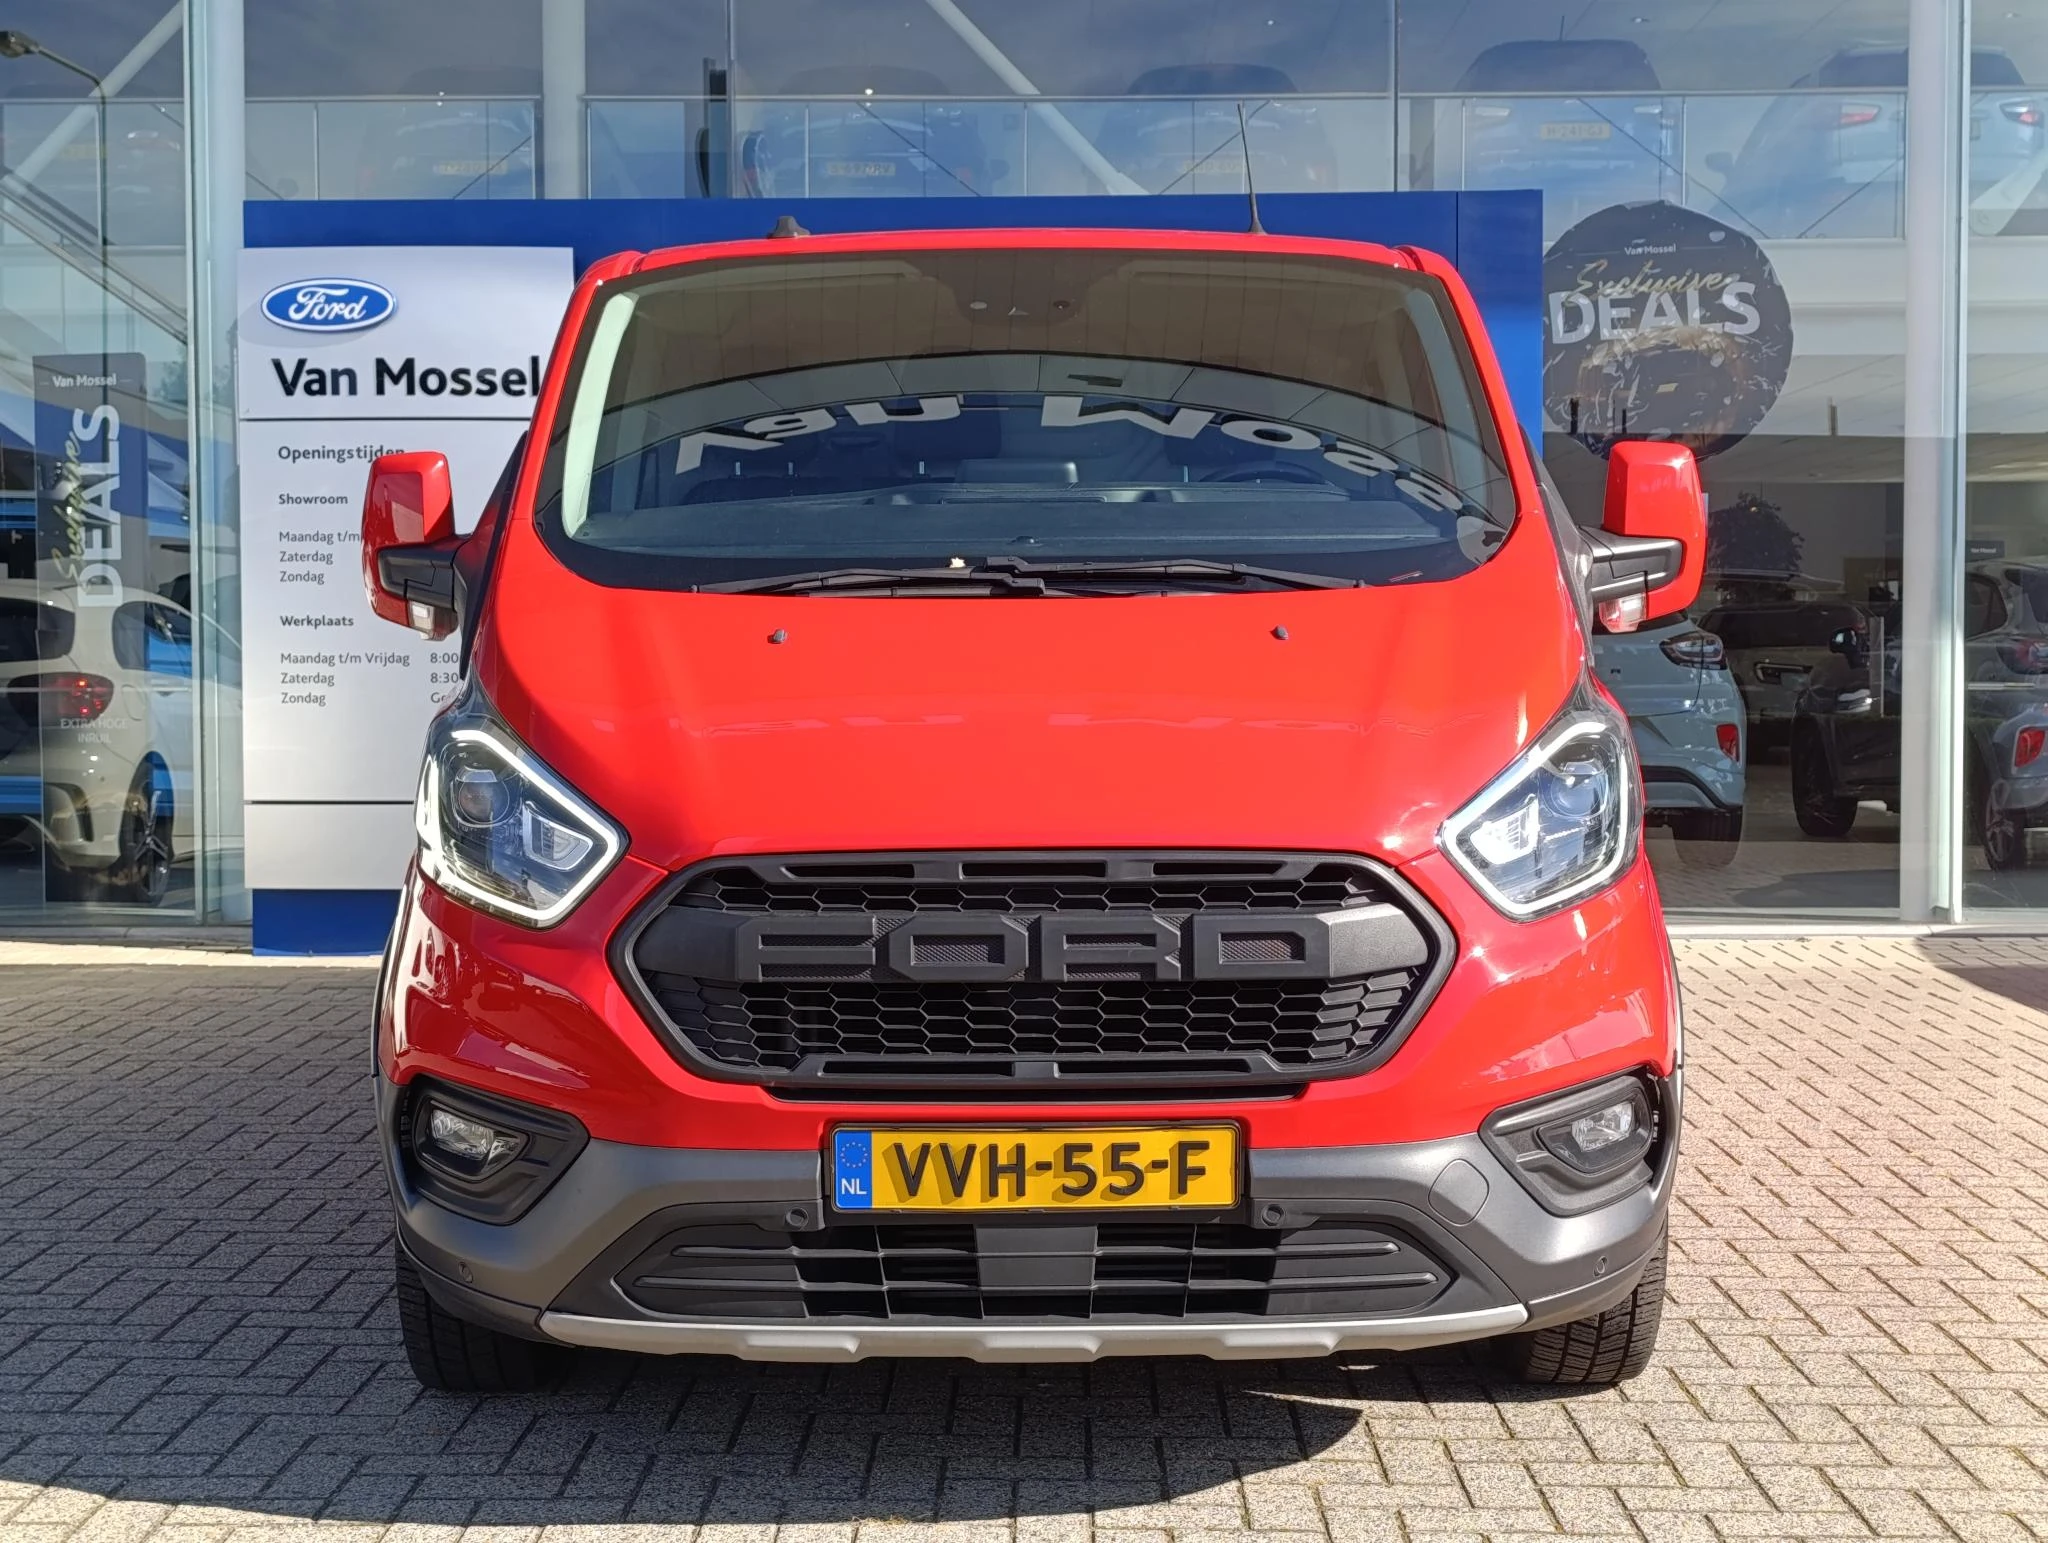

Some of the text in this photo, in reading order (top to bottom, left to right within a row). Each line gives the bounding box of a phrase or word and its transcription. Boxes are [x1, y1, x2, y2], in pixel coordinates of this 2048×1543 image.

[1624, 243, 1677, 256] Van Mossel
[288, 286, 367, 321] Ford
[1548, 281, 1761, 345] DEALS
[52, 372, 118, 388] Van Mossel
[271, 355, 541, 397] Van Mossel
[72, 404, 123, 608] DEALS
[278, 493, 348, 505] Showroom
[279, 529, 360, 546] Maandag t/m
[279, 550, 334, 566] Zaterdag
[279, 570, 325, 586] Zondag
[280, 615, 354, 629] Werkplaats
[280, 652, 459, 667] Maandag t/m Vrijdag 8:00
[280, 671, 459, 687] Zaterdag 8:30
[281, 692, 327, 706] Zondag
[736, 911, 1329, 983] FORD
[893, 1140, 1210, 1199] VVH-55-F
[841, 1178, 867, 1196] NL
